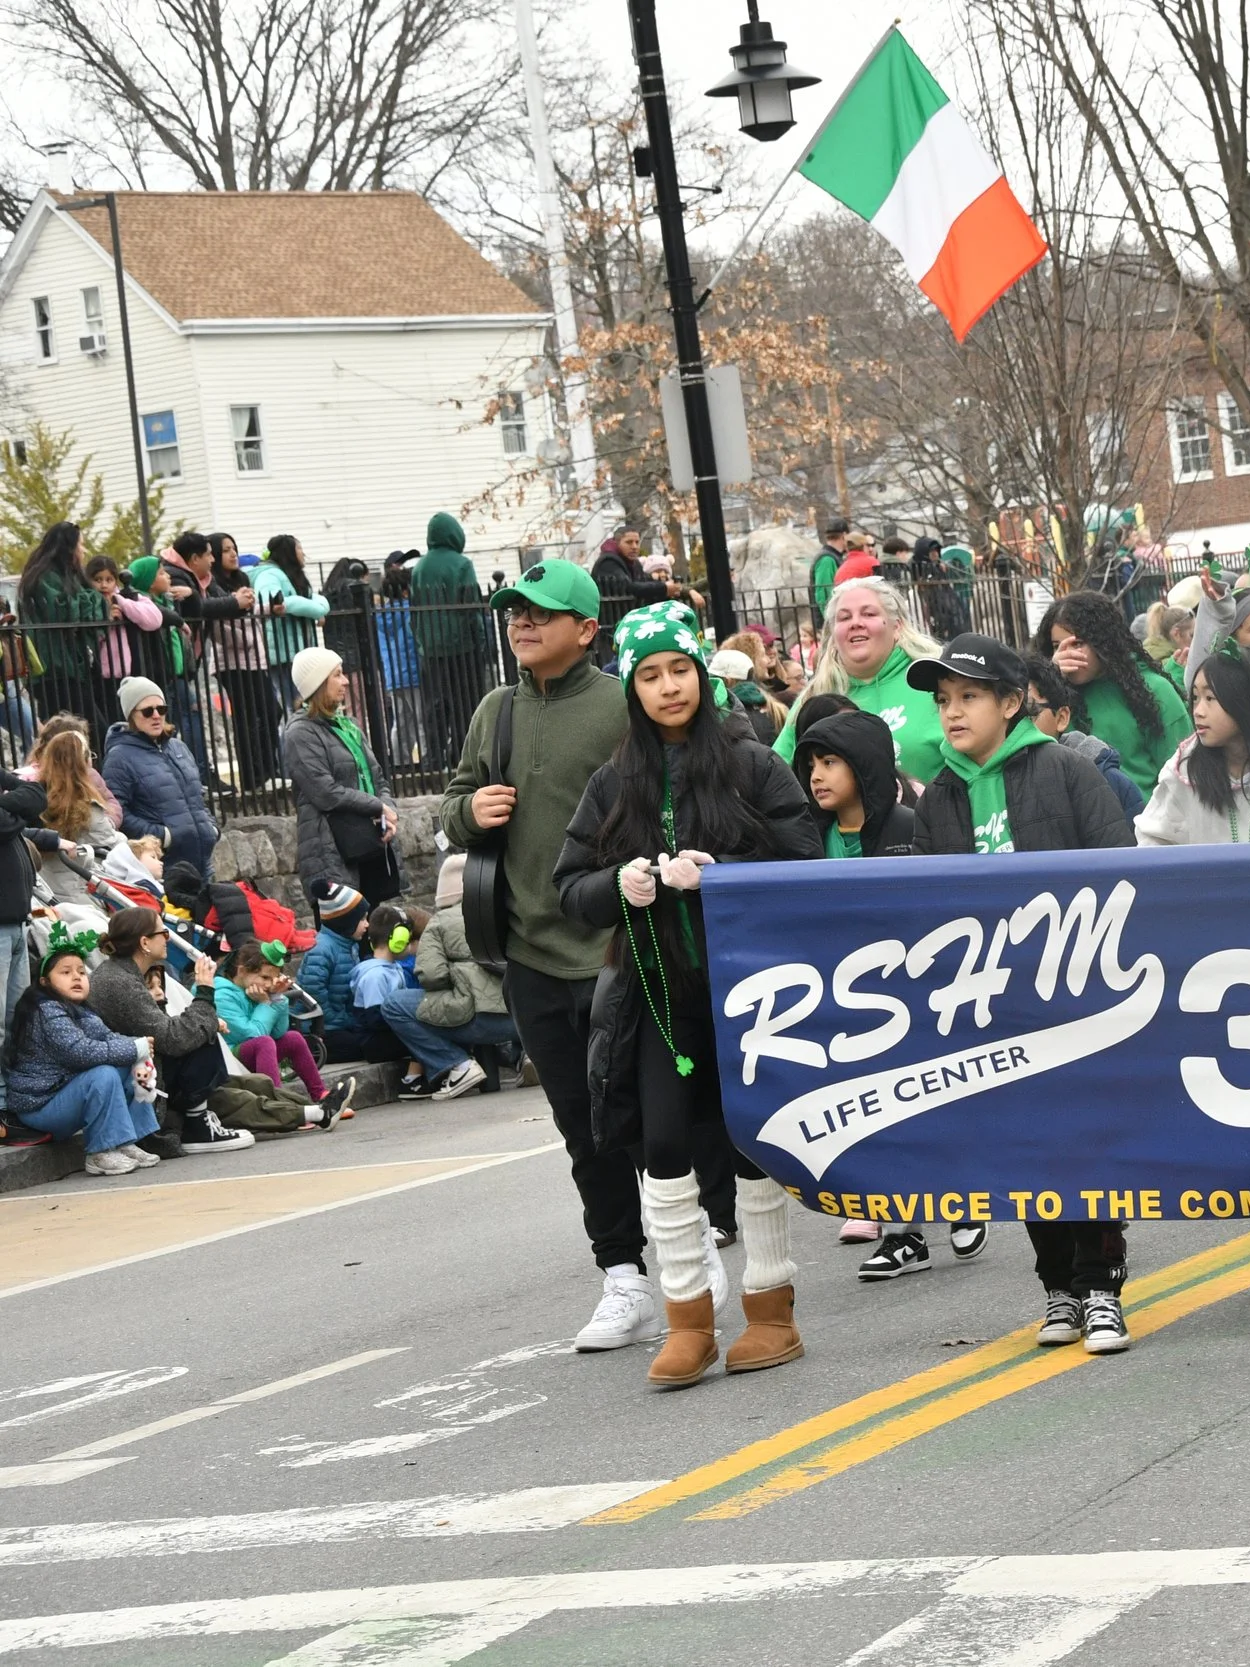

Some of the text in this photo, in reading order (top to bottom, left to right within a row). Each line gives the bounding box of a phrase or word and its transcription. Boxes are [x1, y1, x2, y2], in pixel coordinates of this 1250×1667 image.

[951, 653, 978, 662] Reebok
[725, 880, 1162, 1085] RSHM
[798, 1046, 1031, 1143] LIFE CENTER
[817, 1191, 992, 1222] SERVICE
[1009, 1190, 1063, 1220] TO
[1080, 1190, 1163, 1219] THE
